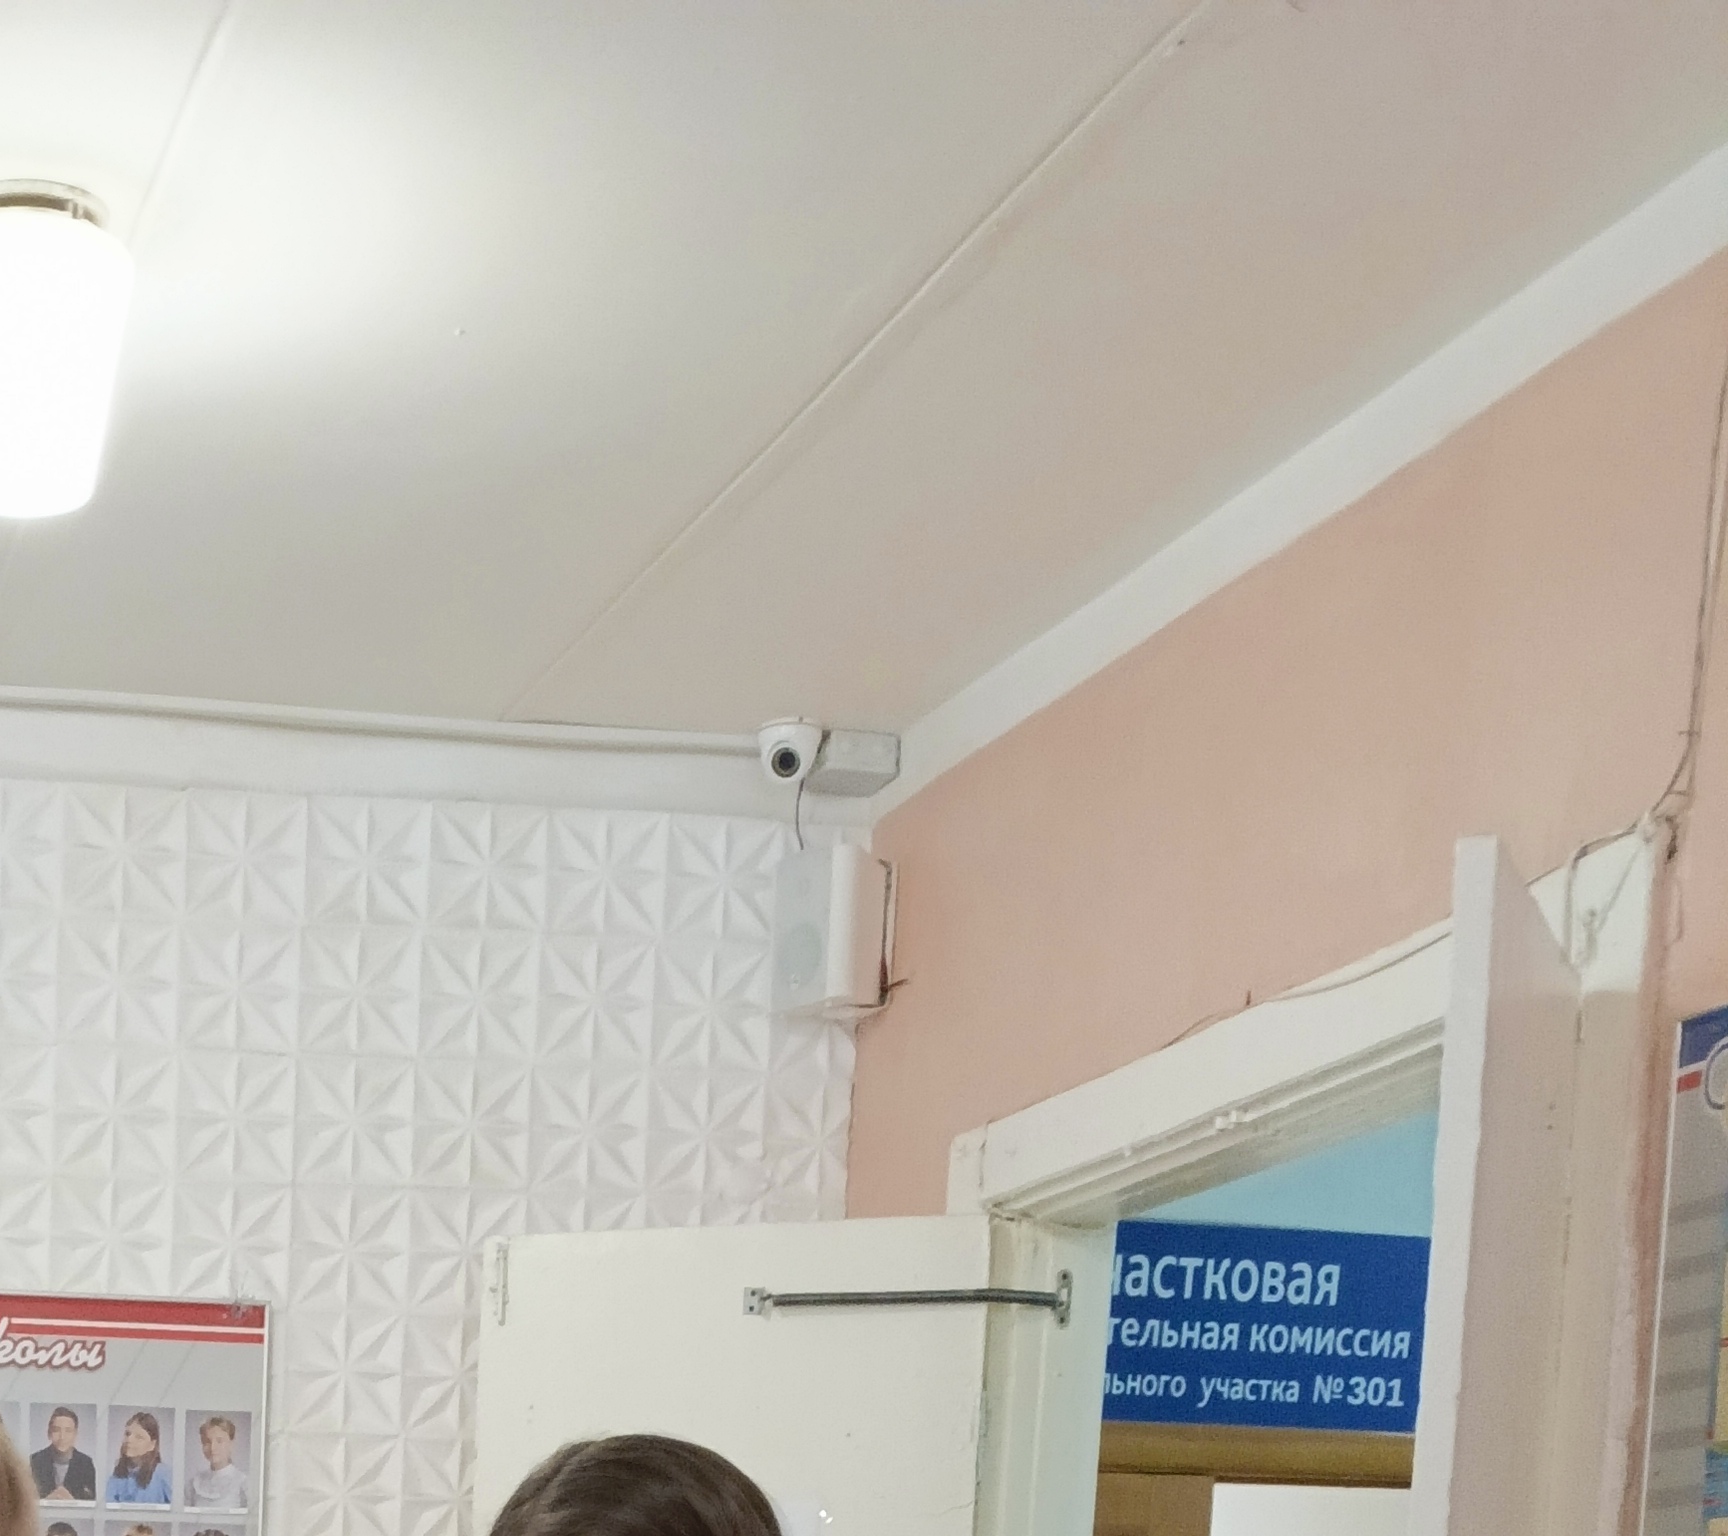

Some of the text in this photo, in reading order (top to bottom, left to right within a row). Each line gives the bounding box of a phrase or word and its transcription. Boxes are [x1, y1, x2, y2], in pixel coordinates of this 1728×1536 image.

[1249, 1324, 1411, 1359] комиссия
[1196, 1375, 1300, 1408] участка
[1312, 1374, 1405, 1408] №301
